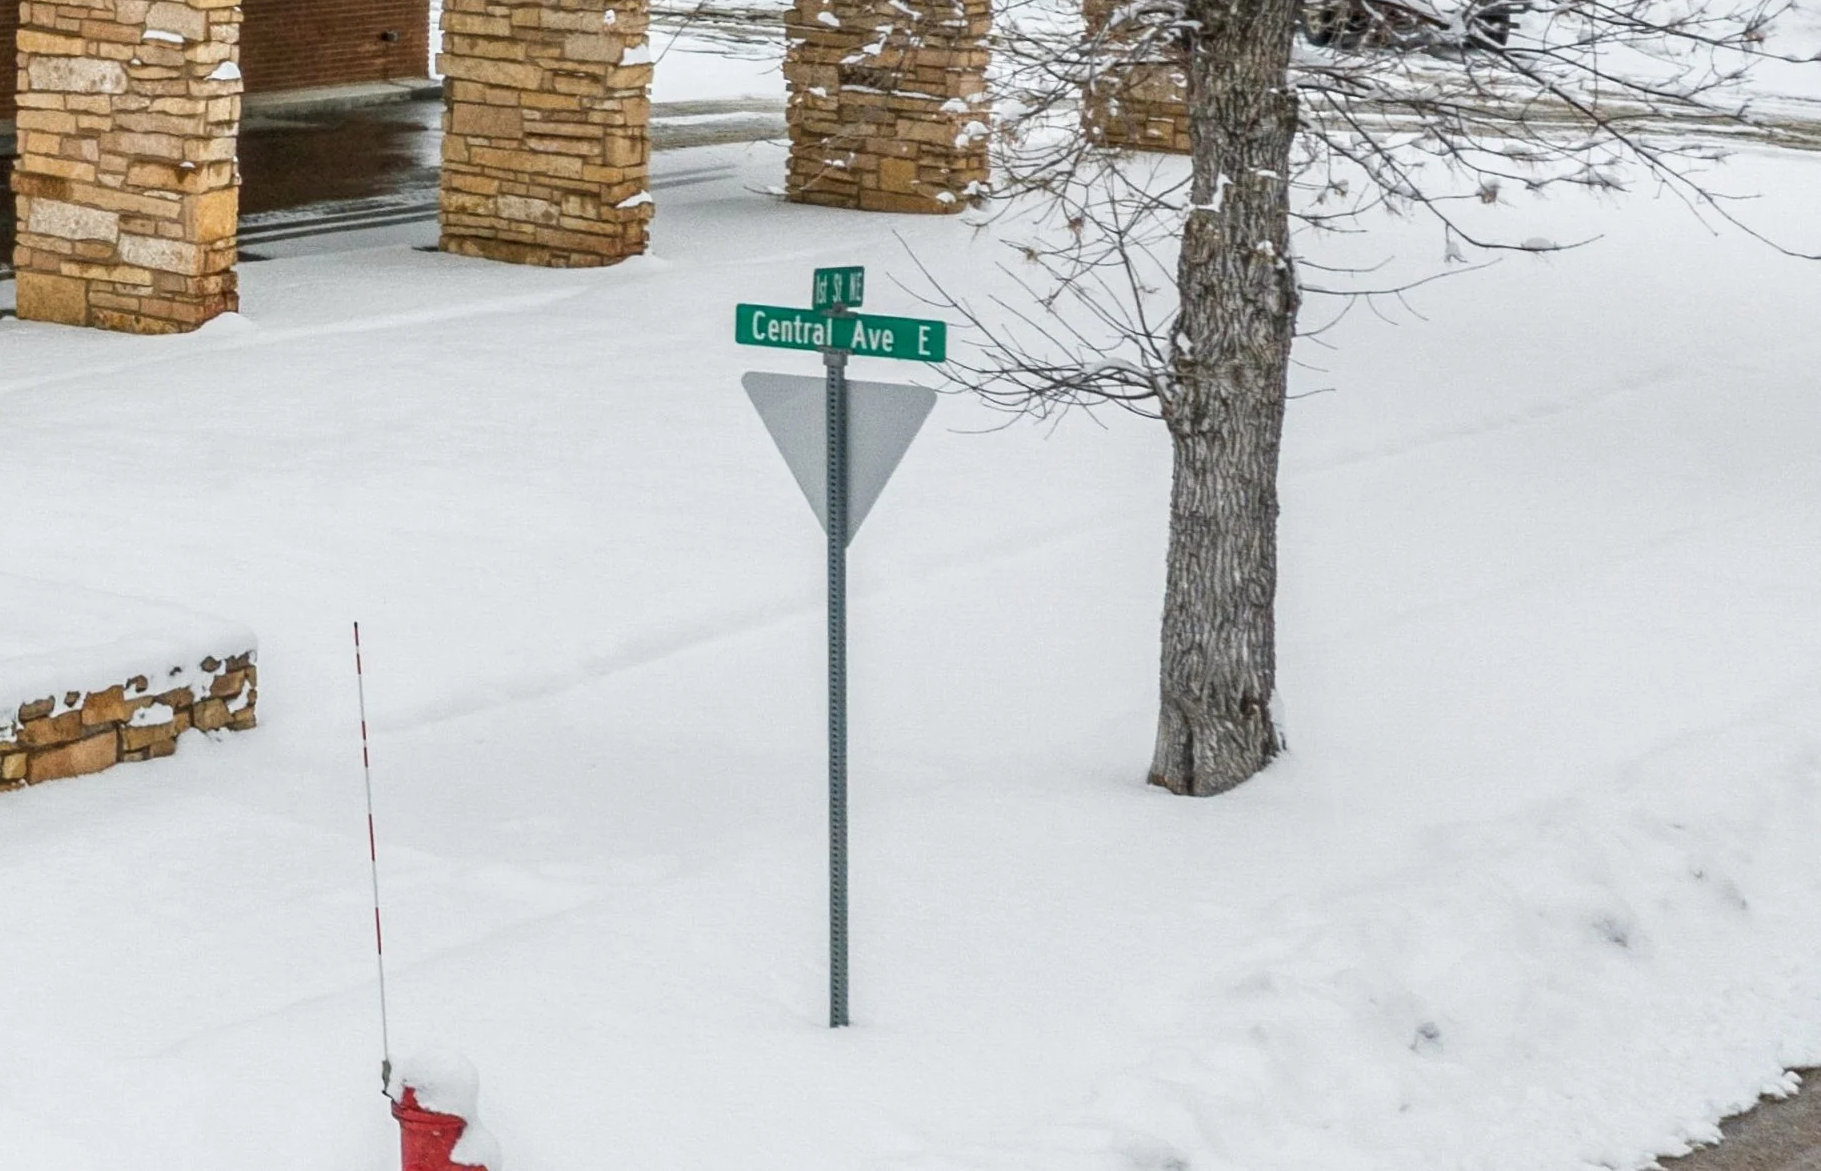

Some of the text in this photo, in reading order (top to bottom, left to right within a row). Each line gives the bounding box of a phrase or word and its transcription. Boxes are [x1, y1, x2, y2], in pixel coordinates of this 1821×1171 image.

[752, 310, 932, 356] Central Ave E
